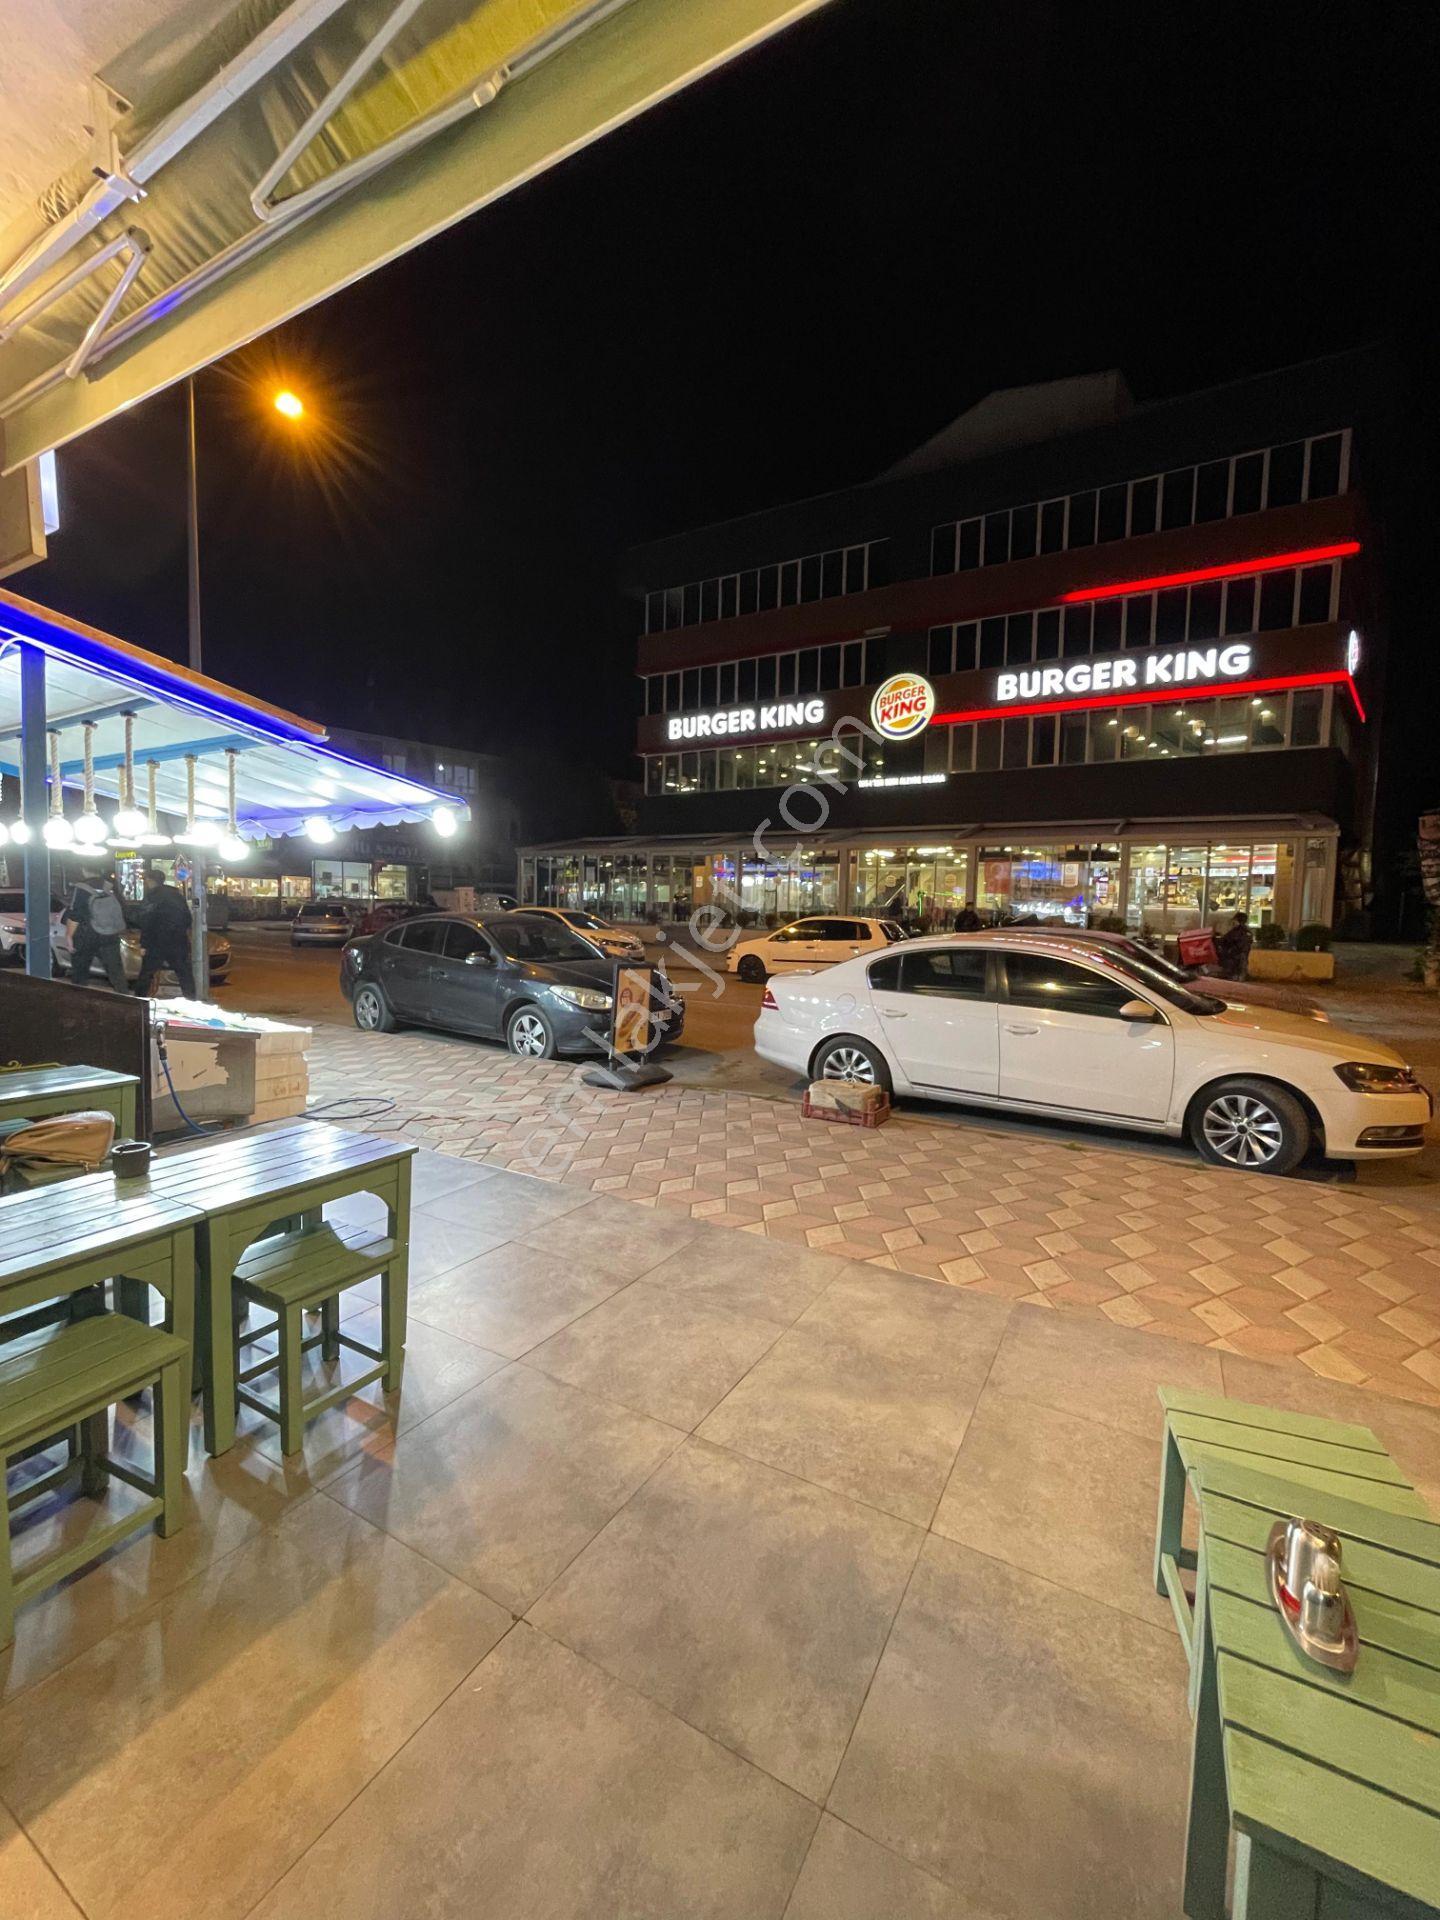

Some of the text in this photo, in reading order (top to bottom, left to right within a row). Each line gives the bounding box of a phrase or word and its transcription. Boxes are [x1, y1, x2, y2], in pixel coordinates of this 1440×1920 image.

[996, 644, 1251, 701] BURGER KING
[880, 685, 926, 708] BURGER
[880, 696, 927, 724] KING
[668, 700, 825, 740] BURGER KING
